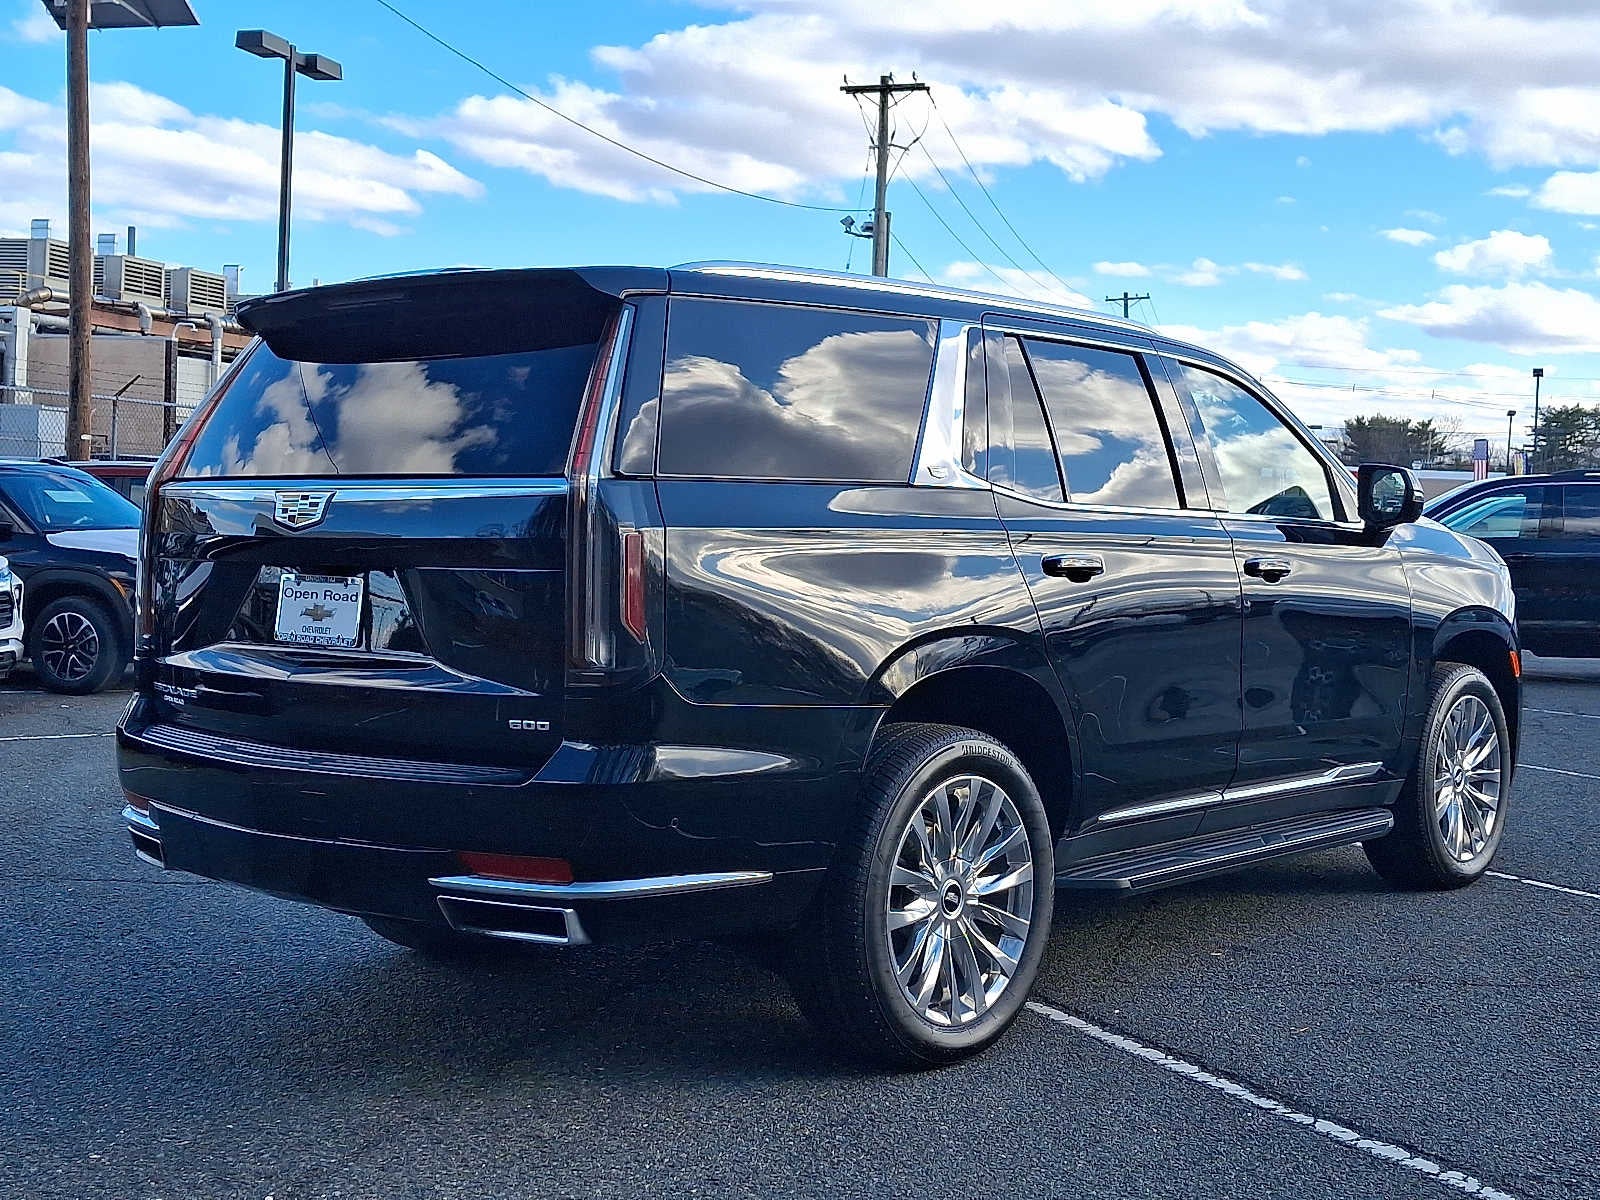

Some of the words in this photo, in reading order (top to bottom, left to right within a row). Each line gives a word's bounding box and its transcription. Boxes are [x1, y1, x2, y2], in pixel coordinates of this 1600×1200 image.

[284, 587, 318, 601] Open
[323, 590, 359, 603] Road
[302, 625, 331, 635] CHEVROLET
[509, 719, 550, 731] 600
[961, 744, 1014, 769] BRIDGESTONE
